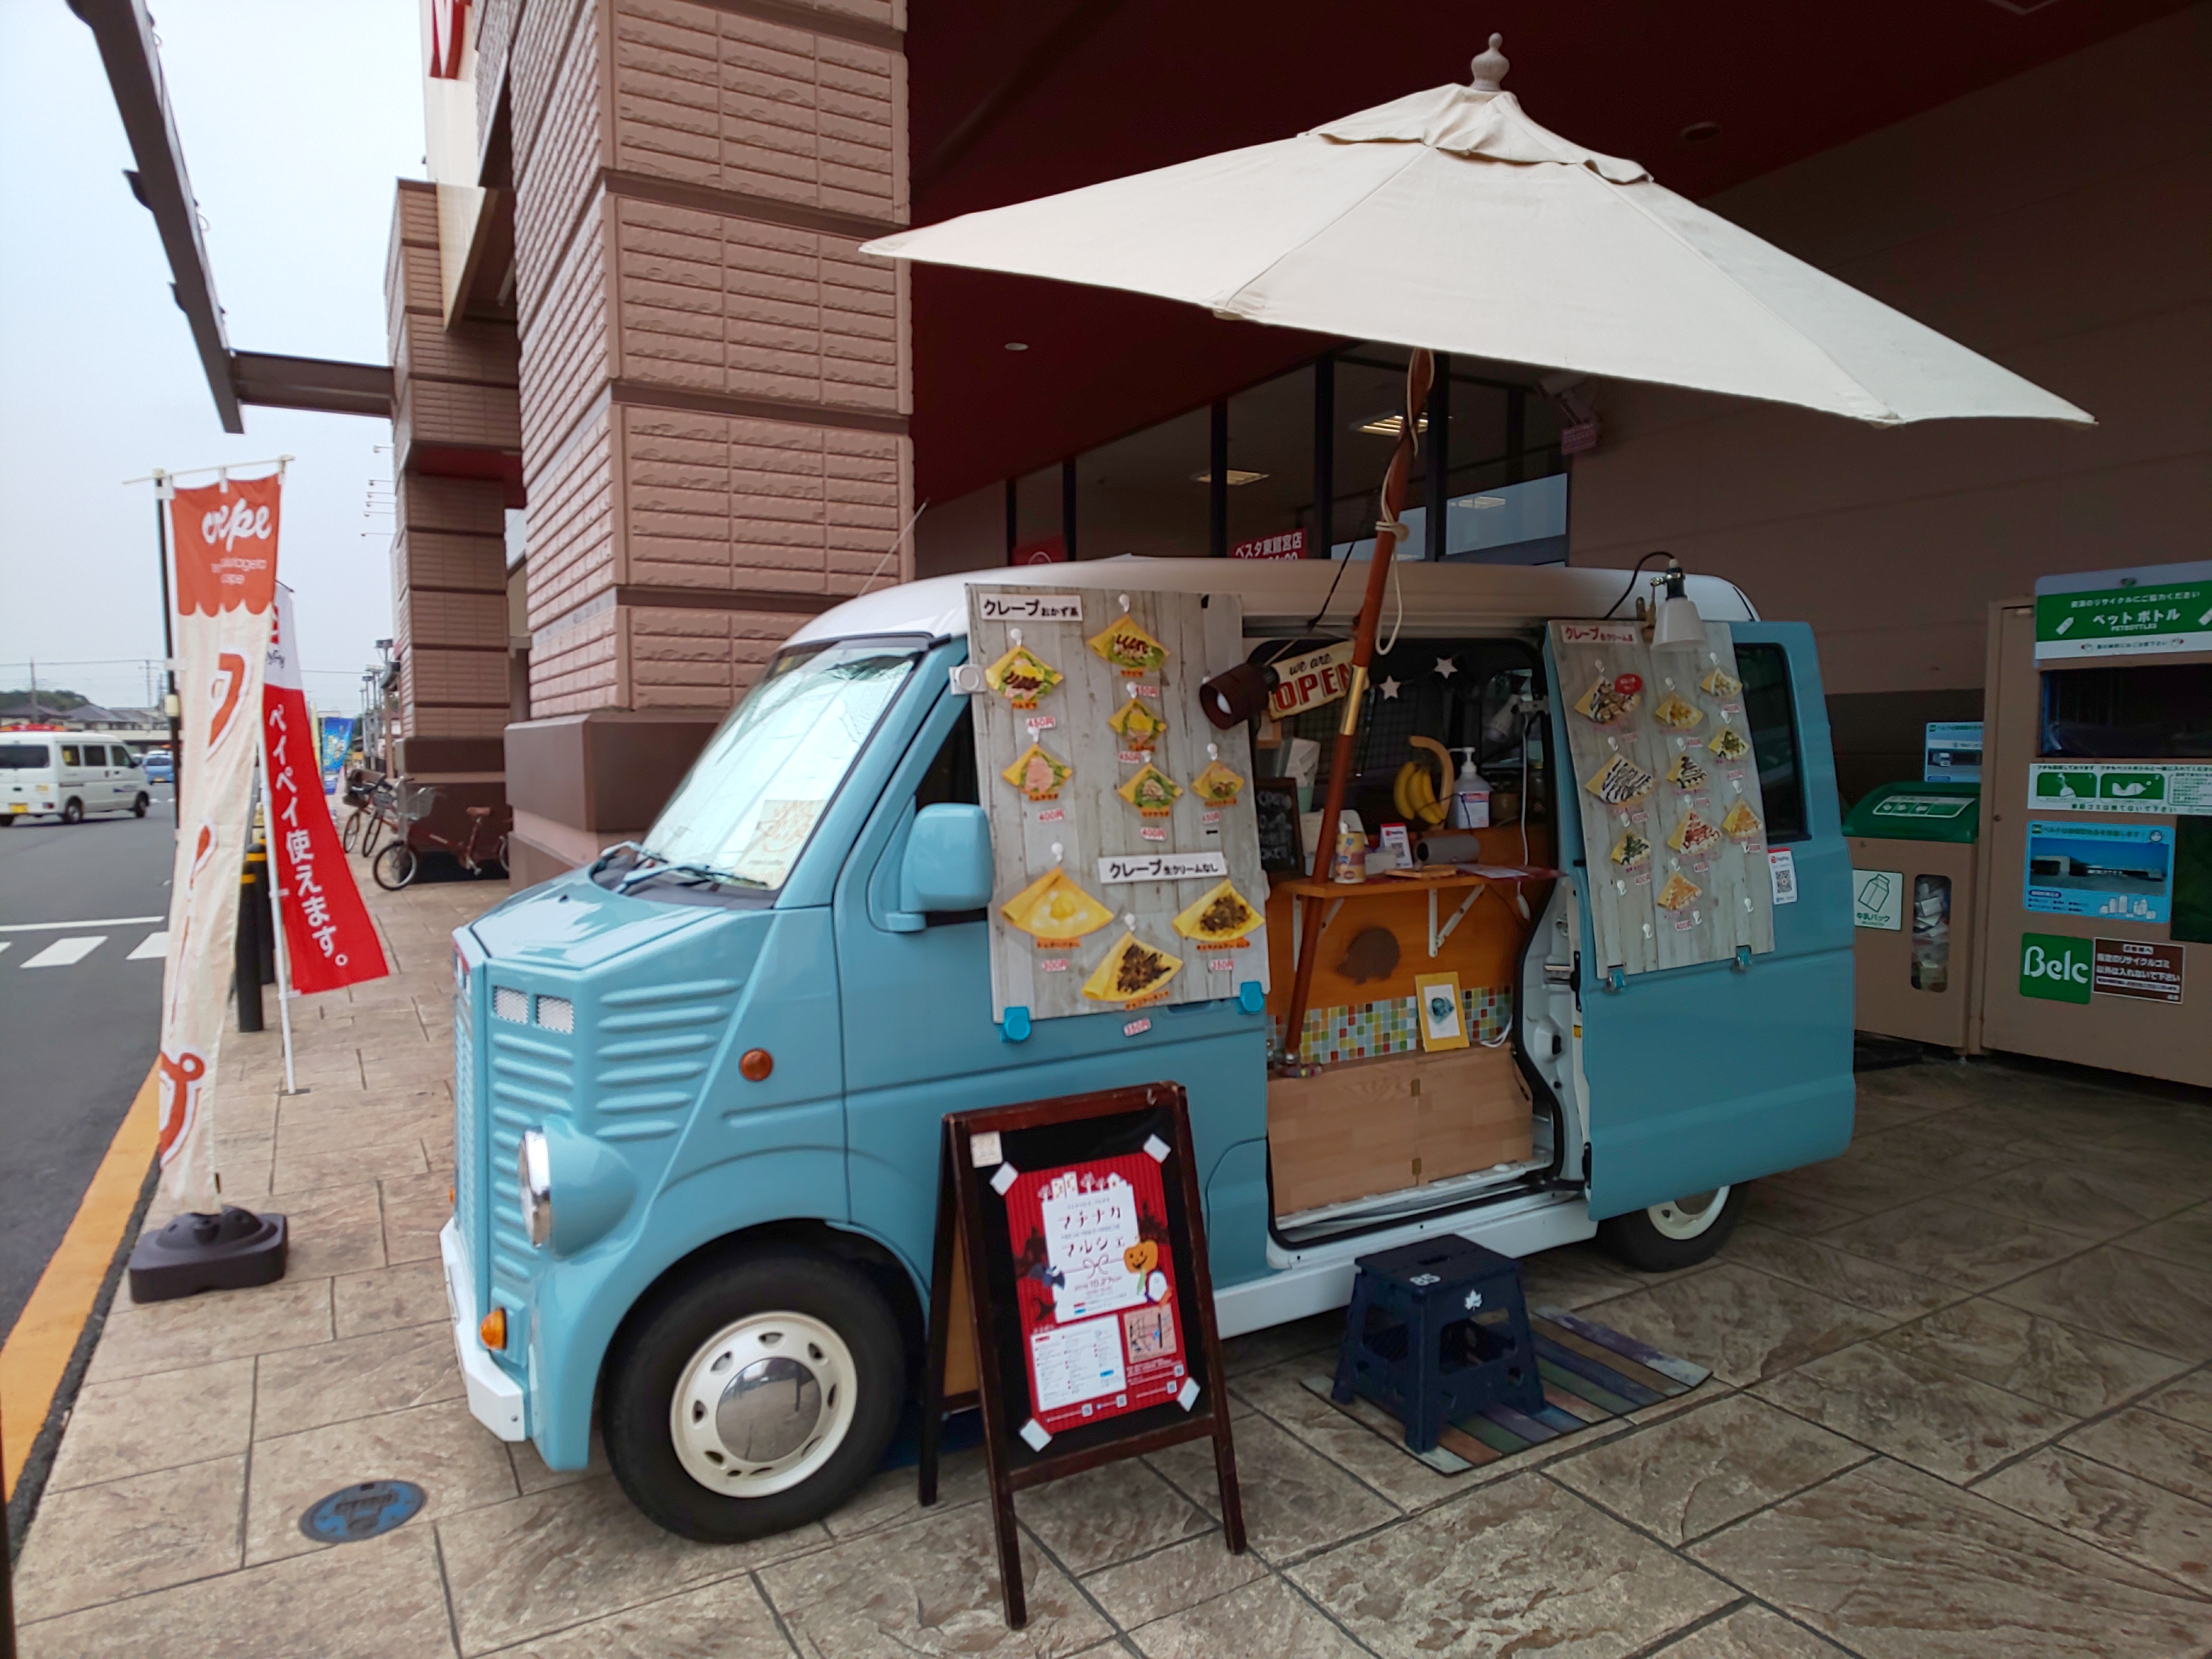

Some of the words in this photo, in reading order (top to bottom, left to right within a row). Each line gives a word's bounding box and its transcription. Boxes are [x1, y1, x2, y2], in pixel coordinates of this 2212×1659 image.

[1290, 661, 1307, 675] we
[1310, 652, 1332, 669] are
[269, 703, 348, 967] ペイペイ使えます。
[2024, 946, 2088, 984] Belc
